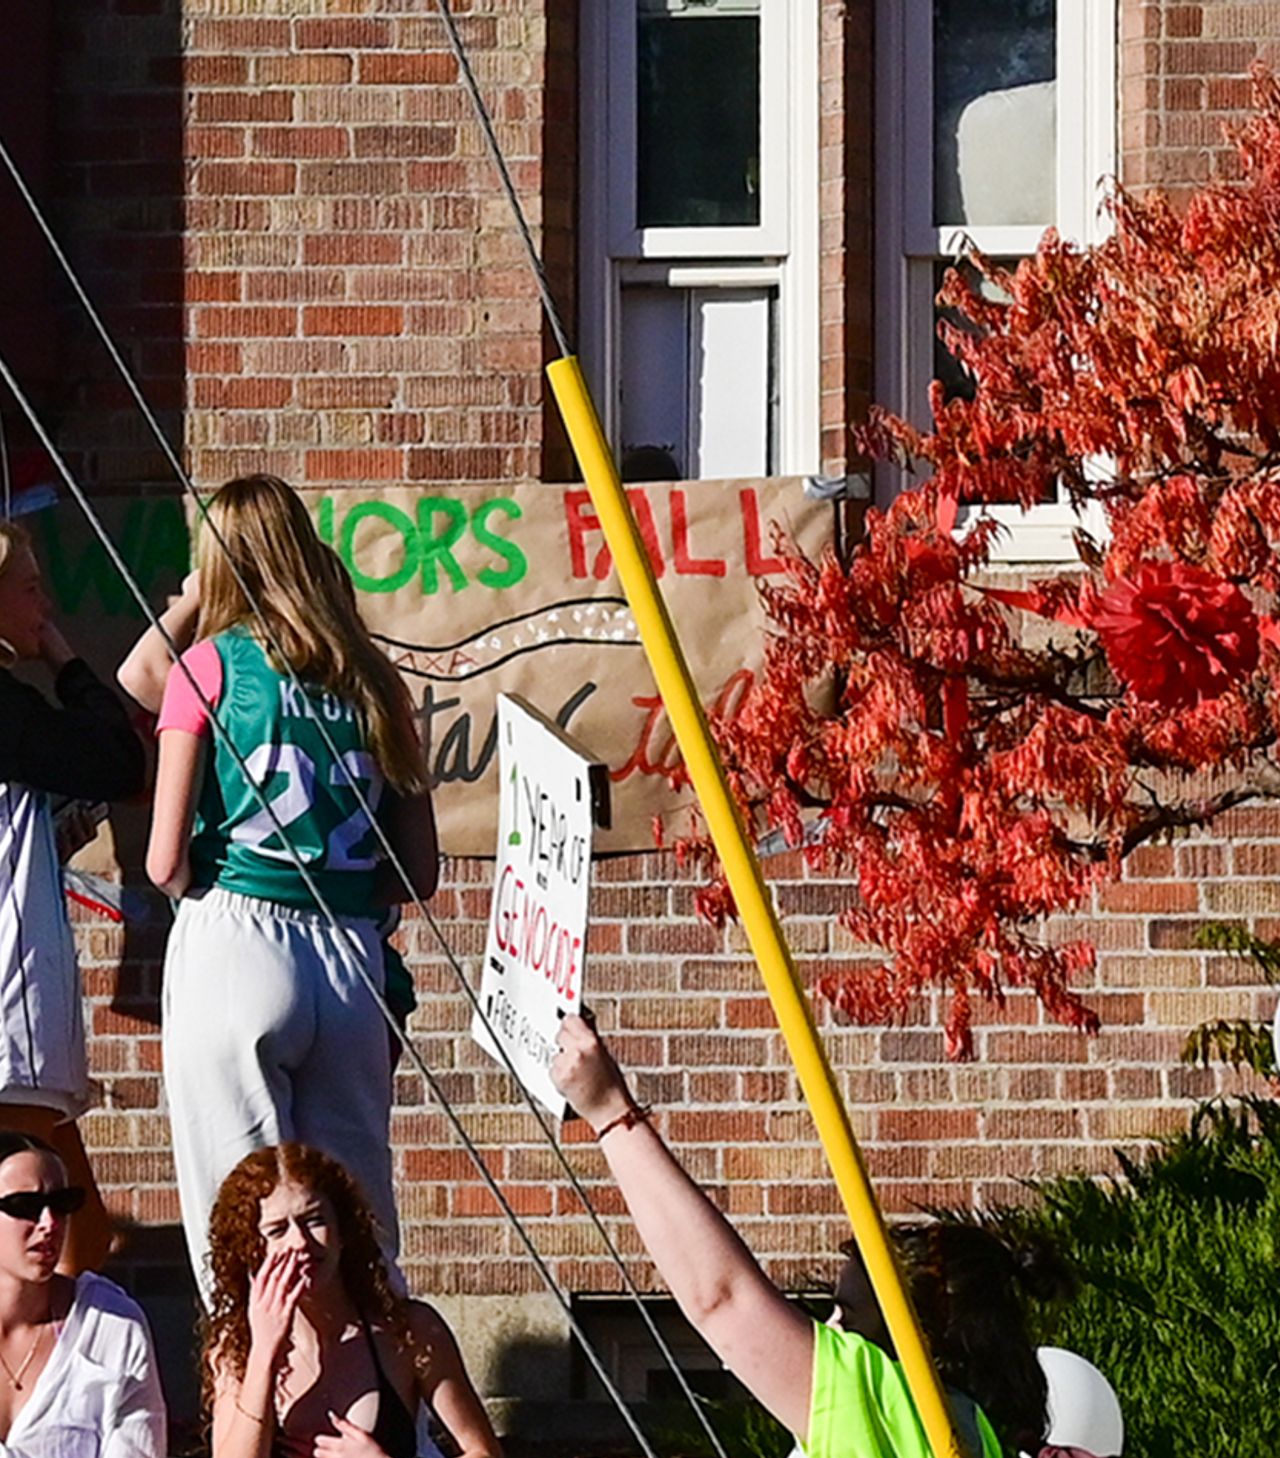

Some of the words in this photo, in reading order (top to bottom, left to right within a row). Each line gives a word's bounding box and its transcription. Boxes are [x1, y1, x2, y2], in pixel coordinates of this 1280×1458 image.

[229, 743, 385, 871] 22
[523, 776, 569, 884] YEAR
[570, 834, 586, 885] OF
[495, 864, 582, 1000] GENOCIDE
